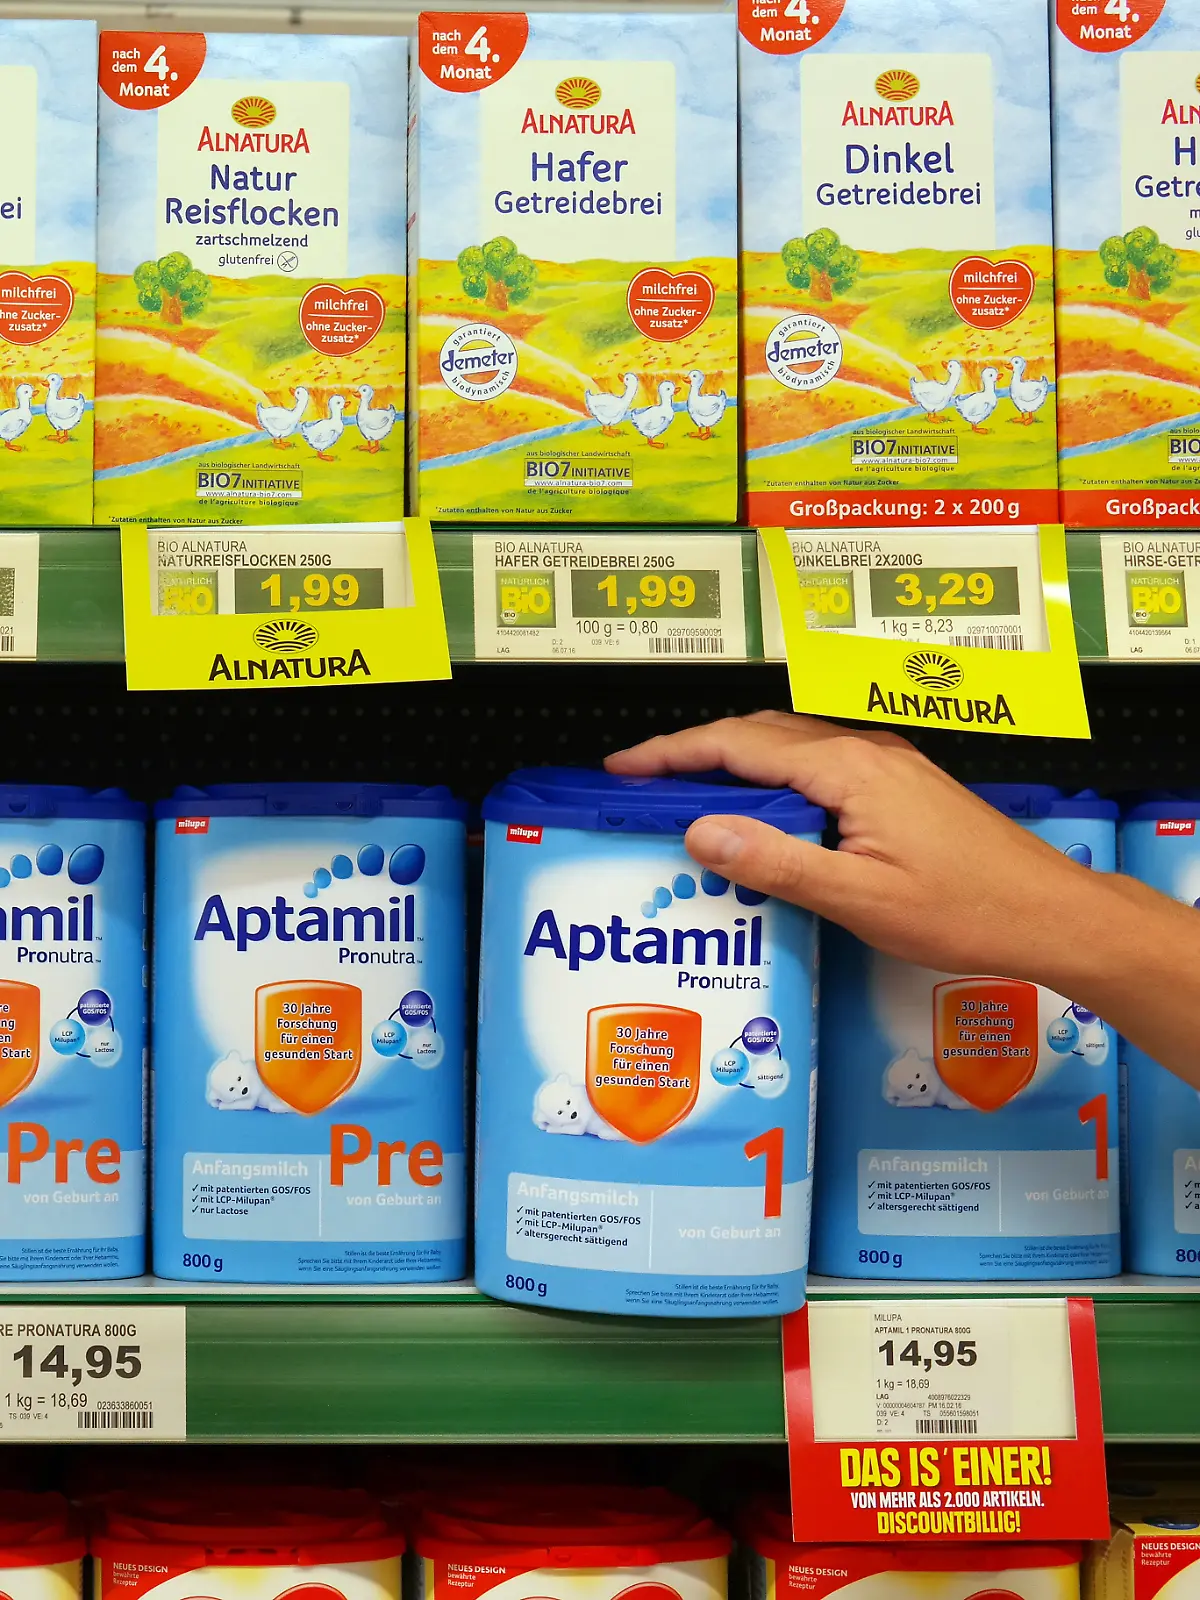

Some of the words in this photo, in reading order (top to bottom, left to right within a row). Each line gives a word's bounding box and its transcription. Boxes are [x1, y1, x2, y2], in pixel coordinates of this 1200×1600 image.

[752, 6, 778, 18] dem
[1072, 4, 1098, 15] dem
[433, 30, 461, 41] nach
[760, 28, 812, 41] Monat
[1080, 25, 1132, 39] Monat
[432, 44, 458, 55] dem
[464, 26, 499, 63] 4.
[112, 48, 140, 60] nach
[112, 62, 137, 73] dem
[144, 45, 178, 80] 4.
[440, 65, 491, 79] Monat
[120, 82, 170, 96] Monat
[522, 108, 636, 134] ALNATURA
[842, 100, 954, 126] ALNATURA
[198, 126, 310, 154] ALNATURA
[846, 142, 954, 174] Dinkel
[532, 151, 628, 182] Hafer
[210, 164, 296, 192] Natur
[816, 182, 980, 206] Getreidebrei
[495, 191, 662, 214] Getreidebrei
[165, 198, 338, 226] Reisflocken
[196, 233, 308, 248] zartschmelzend
[218, 254, 274, 266] glutenfrei
[964, 271, 1017, 284] milchfrei
[2, 287, 57, 300] milchfrei
[642, 282, 697, 296] milchfrei
[314, 299, 368, 312] milchfrei
[956, 296, 980, 305] ohne
[984, 294, 1022, 306] Zucker-
[634, 308, 659, 317] ohne
[662, 306, 701, 318] Zucker-
[306, 322, 330, 332] ohne
[334, 322, 372, 334] Zucker-
[778, 319, 826, 338] garantiert
[453, 328, 501, 346] garantiert
[768, 340, 839, 362] demeter
[442, 350, 514, 372] demeter
[778, 360, 835, 386] biodynamisch
[452, 370, 510, 396] biodynamisch
[540, 450, 579, 458] biologischer
[540, 488, 586, 496] l'agriculture
[588, 488, 630, 496] biologique
[790, 498, 928, 519] Großpackung:
[934, 500, 946, 515] 2
[952, 503, 964, 515] x
[970, 498, 1004, 515] 200
[158, 541, 178, 552] BIO
[182, 541, 248, 552] ALNATURA
[495, 542, 516, 553] BIO
[518, 542, 583, 553] ALNATURA
[816, 541, 881, 552] ALNATURA
[1124, 542, 1144, 553] BIO
[158, 554, 296, 566] NATURREISFLOCKEN
[300, 554, 332, 566] 250G
[496, 556, 539, 568] HAFER
[543, 556, 640, 568] GETREIDEBREI
[644, 556, 674, 568] 250G
[794, 554, 872, 567] DINKELBREI
[876, 554, 922, 566] 2X200G
[261, 574, 359, 612] 1,99
[598, 575, 696, 614] 1,99
[895, 572, 994, 614] 3,29
[576, 620, 600, 634] 100
[604, 622, 612, 637] g
[630, 620, 658, 636] 0,80
[881, 620, 886, 632] 1
[892, 619, 907, 636] kg
[925, 619, 954, 635] 8,23
[209, 649, 371, 681] ALNATURA
[867, 682, 1016, 726] ALNATURA
[178, 820, 206, 829] milupa
[510, 827, 539, 838] milupa
[283, 1003, 298, 1014] 30
[300, 1003, 330, 1014] Jahre
[277, 1019, 337, 1030] Forschung
[280, 1034, 299, 1044] für
[302, 1034, 333, 1044] einen
[264, 1049, 320, 1061] gesunden
[323, 1049, 352, 1060] Start
[8, 1122, 120, 1184] Pre
[330, 1124, 443, 1187] Pre
[744, 1127, 784, 1220] 1
[517, 1181, 639, 1208] Anfangsmilch
[525, 1208, 540, 1217] mit
[542, 1209, 598, 1224] patentierten
[600, 1214, 641, 1225] GOS/FOS
[525, 1218, 540, 1228] mit
[524, 1229, 582, 1244] altersgerecht
[584, 1234, 628, 1248] sättigend
[678, 1228, 706, 1238] von
[710, 1226, 760, 1240] Geburt
[764, 1227, 781, 1238] an
[183, 1254, 211, 1268] 800
[214, 1258, 223, 1272] g
[505, 1274, 534, 1292] 800
[538, 1281, 548, 1296] g
[18, 1324, 100, 1336] PRONATURA
[105, 1324, 136, 1336] 800G
[878, 1340, 977, 1372] 14,95
[14, 1345, 142, 1387] 14,95
[877, 1379, 880, 1388] 1
[884, 1379, 894, 1390] kg
[906, 1379, 930, 1390] 18,69
[5, 1393, 10, 1407] 1
[17, 1393, 32, 1411] kg
[51, 1393, 88, 1409] 18,69
[97, 1401, 152, 1410] 023633860051
[840, 1447, 900, 1487] DAS
[953, 1446, 1052, 1486] EINER!
[850, 1492, 876, 1508] VON
[880, 1492, 916, 1508] MEHR
[919, 1492, 941, 1508] ALS
[944, 1491, 980, 1508] 2.000
[982, 1490, 1044, 1508] ARTIKELN.
[877, 1511, 1020, 1534] DISCOUNTBILLIG!
[448, 1564, 473, 1572] NEUES
[474, 1565, 506, 1574] DESIGN
[1142, 1558, 1170, 1567] Rezeptur
